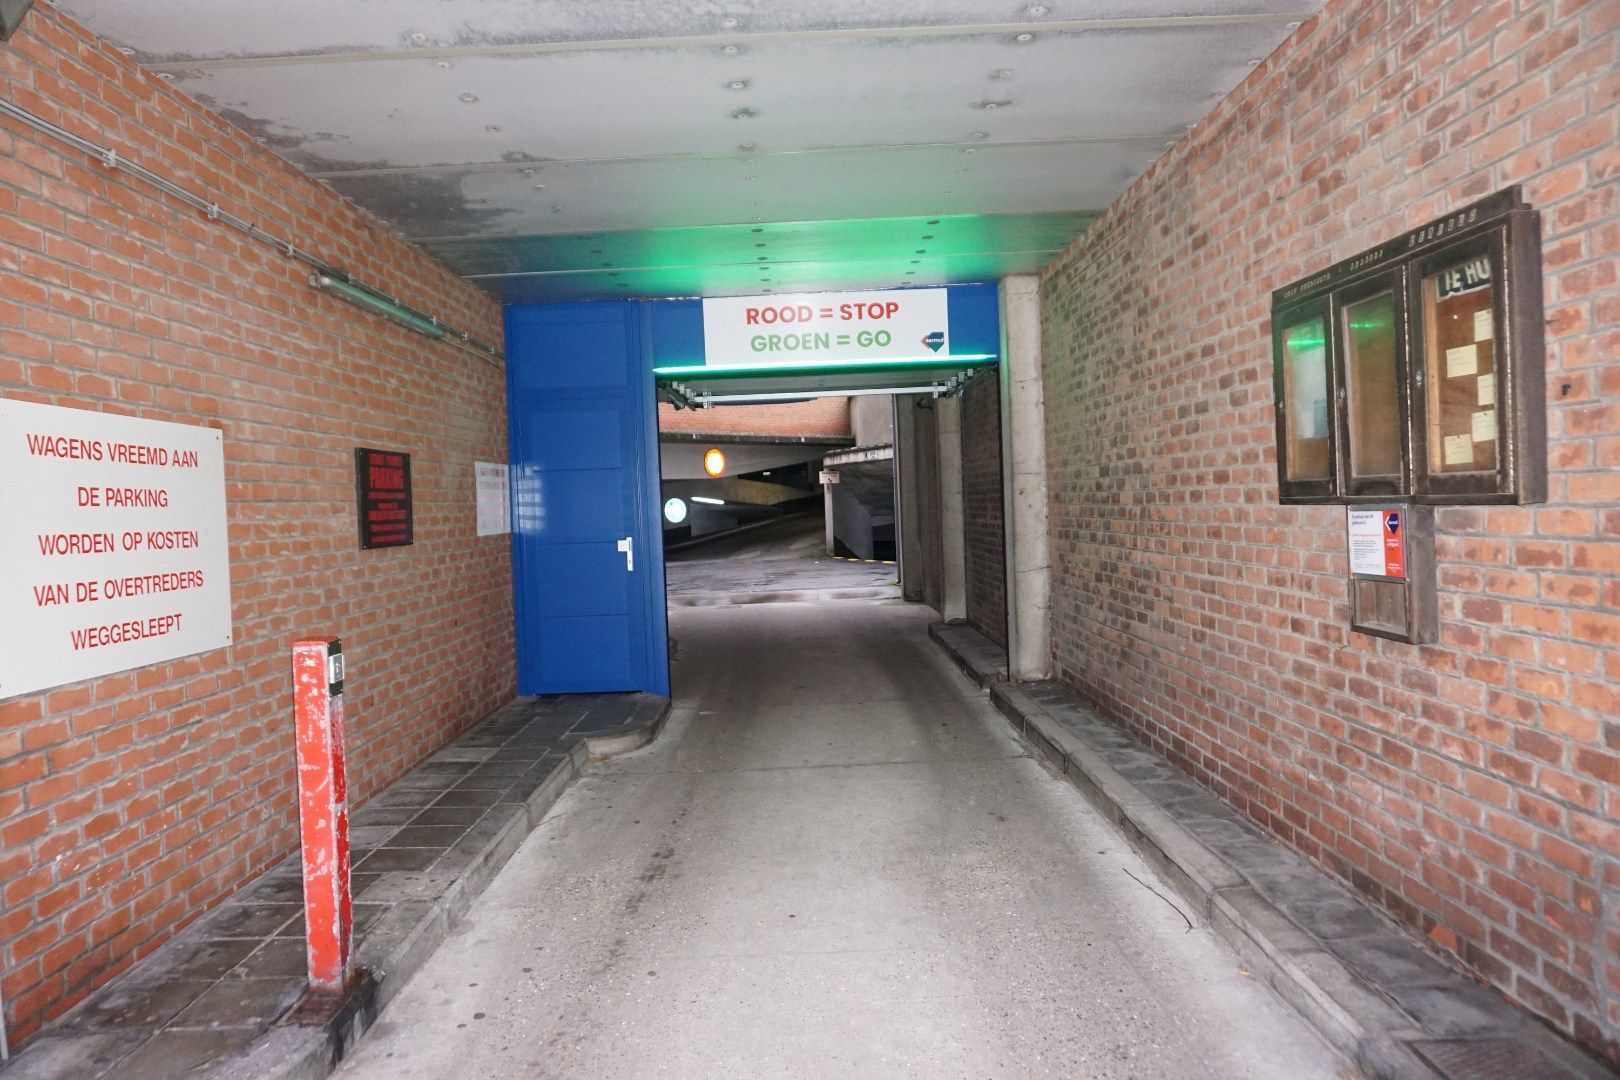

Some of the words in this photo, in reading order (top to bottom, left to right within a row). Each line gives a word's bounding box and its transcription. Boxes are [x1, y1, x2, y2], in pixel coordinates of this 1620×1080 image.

[745, 305, 813, 325] ROOD
[820, 307, 834, 319] =
[839, 301, 900, 321] STOP
[750, 332, 830, 352] GROEN
[836, 334, 851, 346] =
[856, 329, 892, 348] GO
[26, 433, 103, 461] WAGENS
[107, 443, 168, 466] VREEMD
[172, 448, 198, 467] AAN
[77, 486, 100, 507] DE
[105, 487, 168, 508] PARKING
[38, 533, 115, 555] WORDEN
[122, 531, 143, 551] OP
[147, 530, 199, 550] KOSTEN
[34, 584, 69, 606] VAN
[76, 581, 98, 602] DE
[104, 570, 203, 600] OVERTREDERS
[71, 613, 182, 650] WEGGESLEEPT
